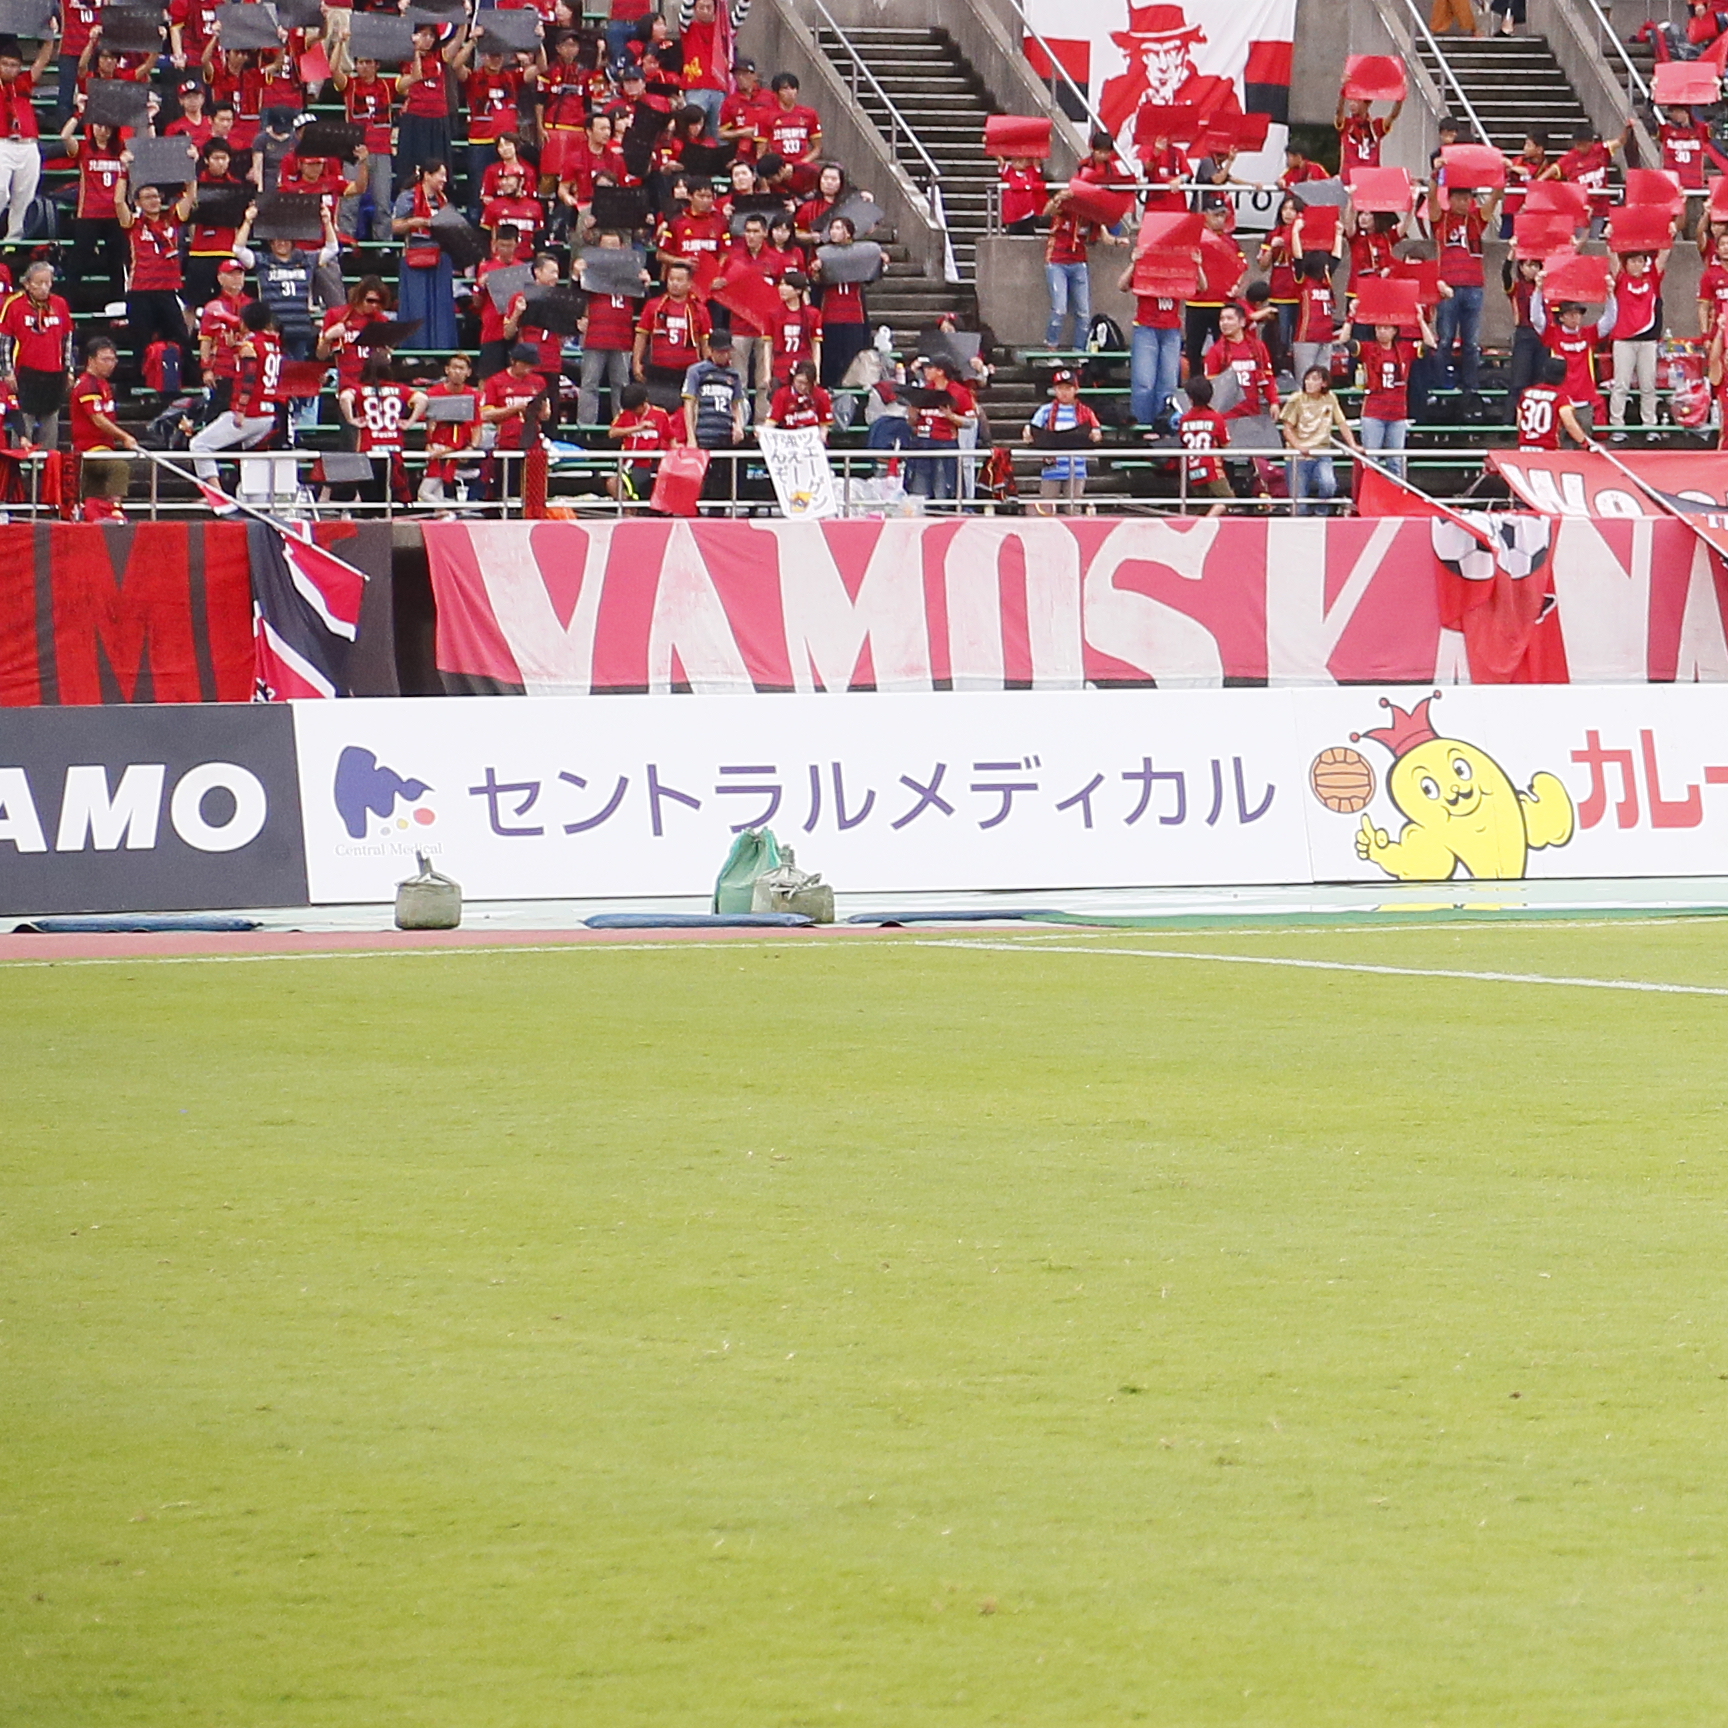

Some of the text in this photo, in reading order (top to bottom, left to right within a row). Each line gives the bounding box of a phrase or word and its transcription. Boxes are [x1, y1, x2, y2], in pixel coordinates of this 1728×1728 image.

[364, 397, 400, 427] 88
[1520, 399, 1552, 434] 30
[468, 754, 1275, 835] セントラルメディカル
[335, 843, 443, 856] Central Medical
